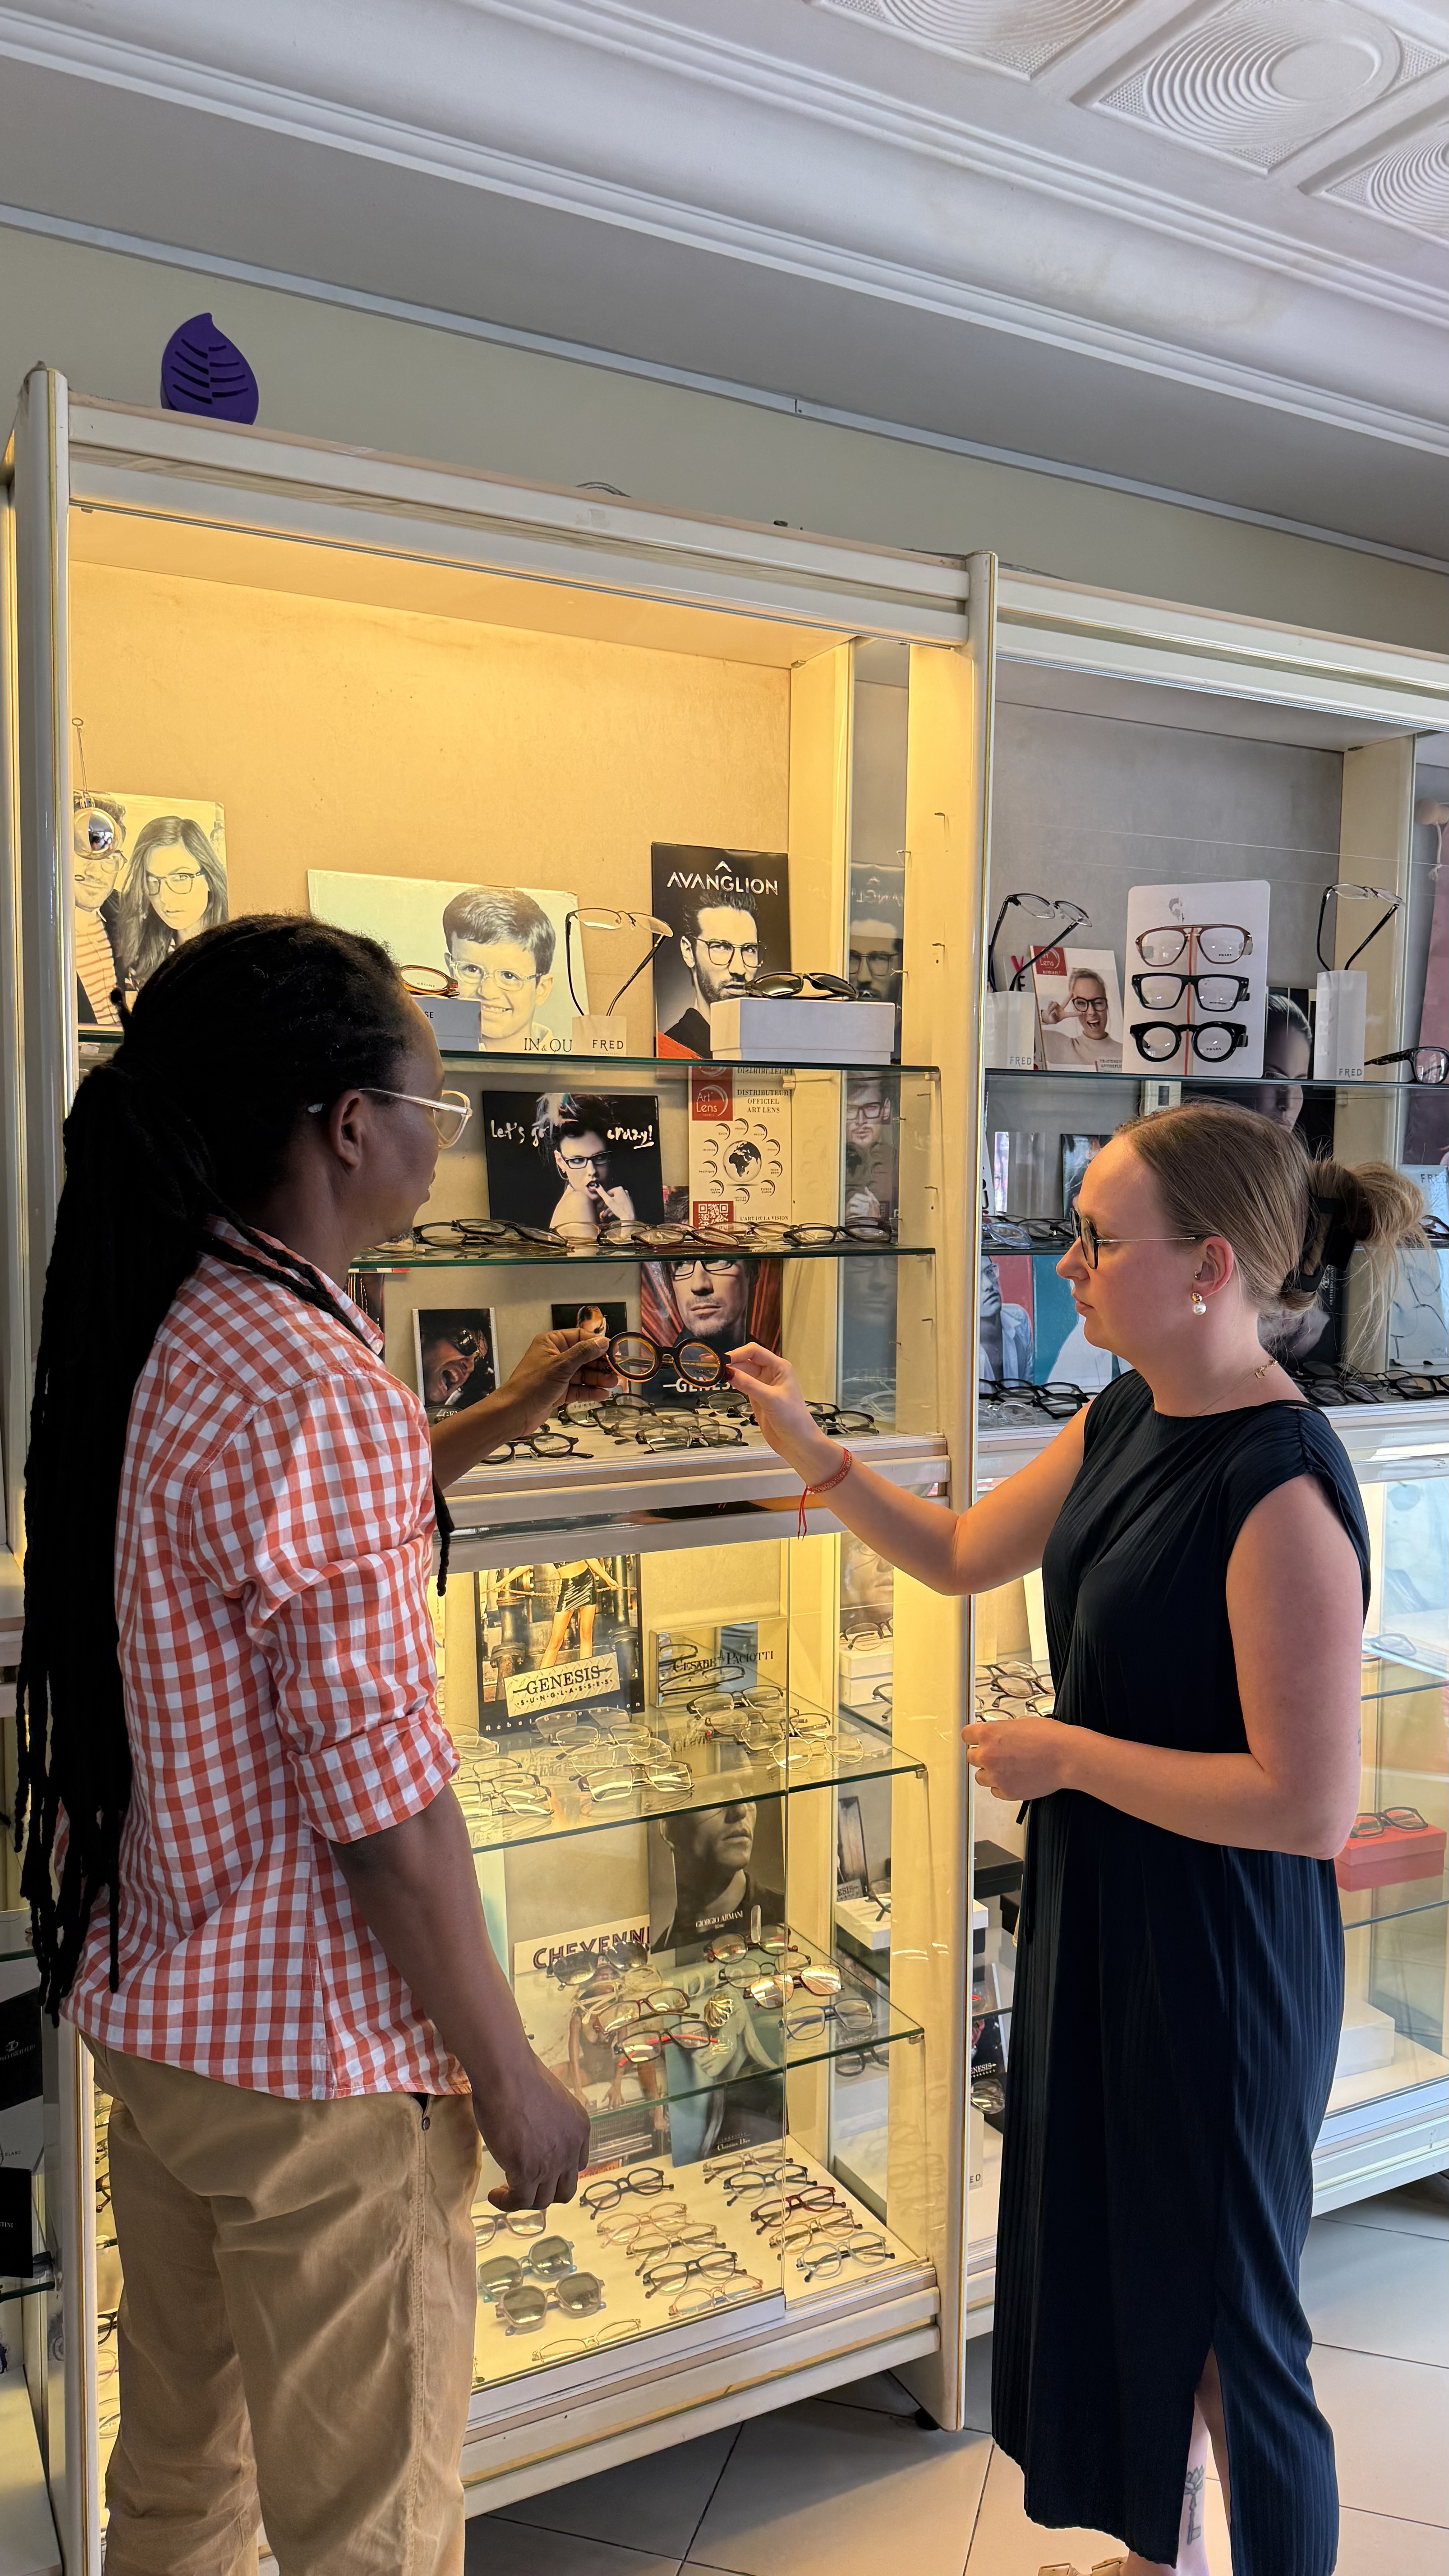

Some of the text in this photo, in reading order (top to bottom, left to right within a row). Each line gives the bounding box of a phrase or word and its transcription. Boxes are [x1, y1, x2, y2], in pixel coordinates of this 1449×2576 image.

[667, 872, 778, 896] AVANGLION
[524, 1038, 540, 1051] IN
[593, 1039, 624, 1051] FRED
[1010, 1056, 1032, 1067] FRED
[1339, 1068, 1362, 1077] FRED
[696, 1102, 718, 1113] Lens
[607, 1125, 654, 1145] crazy!
[727, 1651, 774, 1665] PACIOTTI
[526, 1665, 601, 1694] GENESIS
[533, 1926, 649, 1969] CHEYENN
